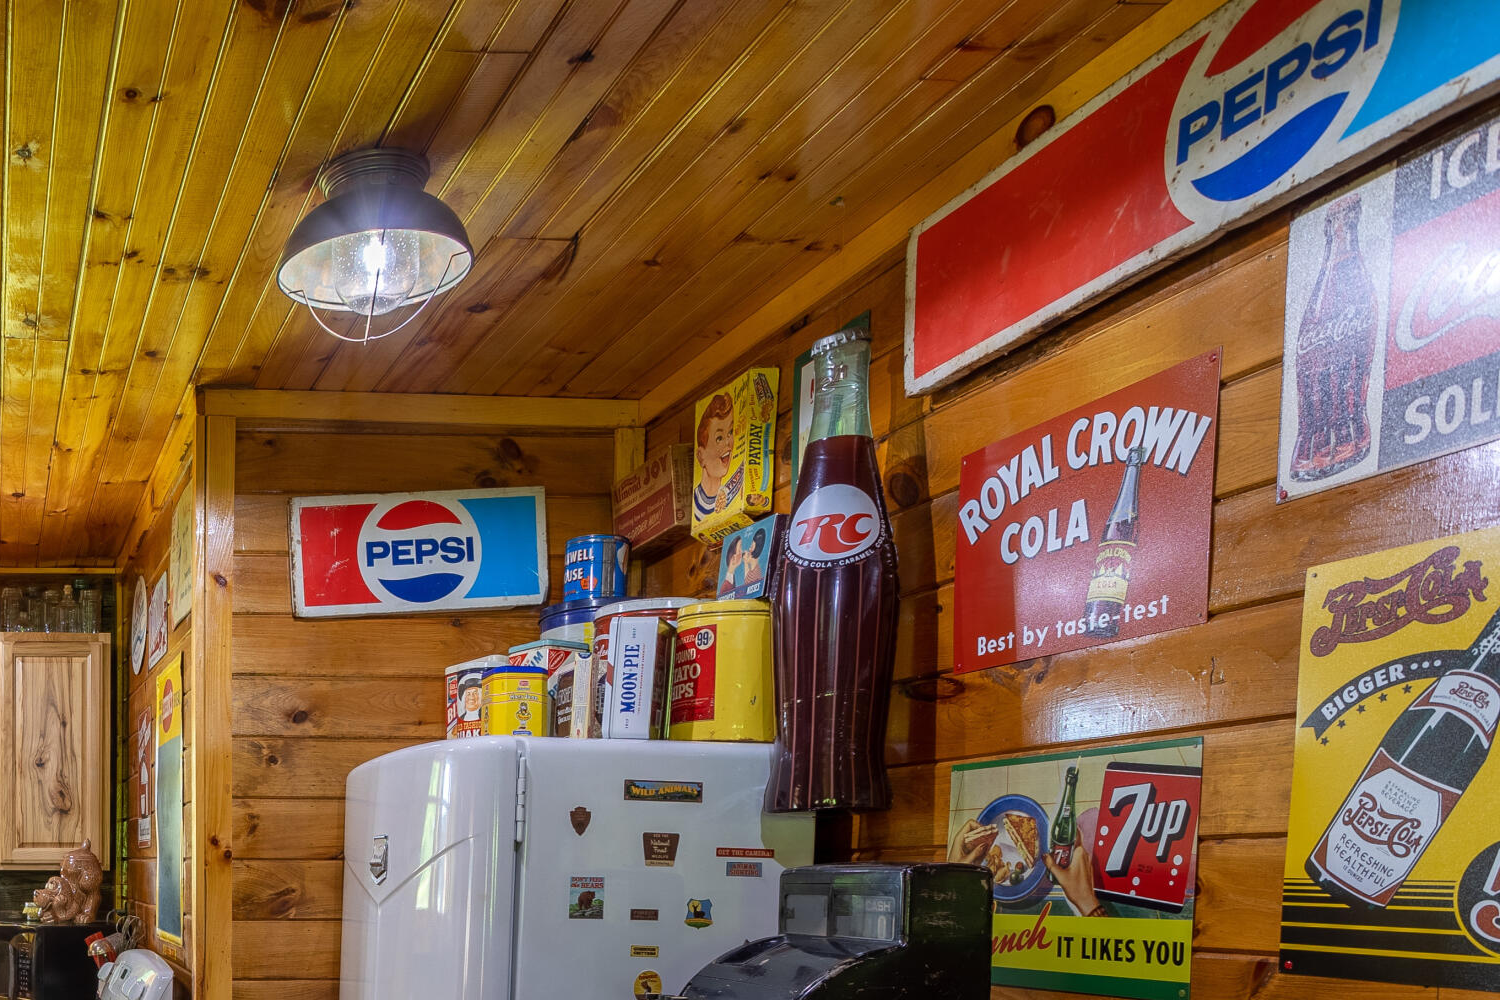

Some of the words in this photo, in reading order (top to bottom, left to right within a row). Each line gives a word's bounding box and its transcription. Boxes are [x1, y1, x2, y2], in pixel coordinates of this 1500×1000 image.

[1176, 0, 1383, 166] PEPSI
[1403, 372, 1500, 444] SOL
[749, 424, 762, 465] PAYDAY
[643, 453, 667, 485] JOY
[958, 434, 1060, 545] ROYAL
[1067, 406, 1212, 475] CROWN
[365, 536, 475, 567] PEPSI
[796, 513, 874, 553] RC
[1001, 499, 1089, 565] COLA
[839, 548, 875, 567] CARAMEL
[977, 631, 1015, 656] Best
[1023, 625, 1049, 647] by
[1056, 594, 1169, 637] taste-test
[624, 644, 640, 668] PIE
[620, 672, 638, 714] MOON
[457, 729, 480, 738] QUAK
[631, 785, 656, 796] WILD
[658, 784, 698, 796] ANIMALS
[1334, 844, 1388, 888] HEALTHFUL
[1341, 832, 1395, 878] REFRESHING
[1057, 936, 1071, 958] IT
[1081, 937, 1135, 963] LIKES
[1143, 940, 1185, 966] YOU
